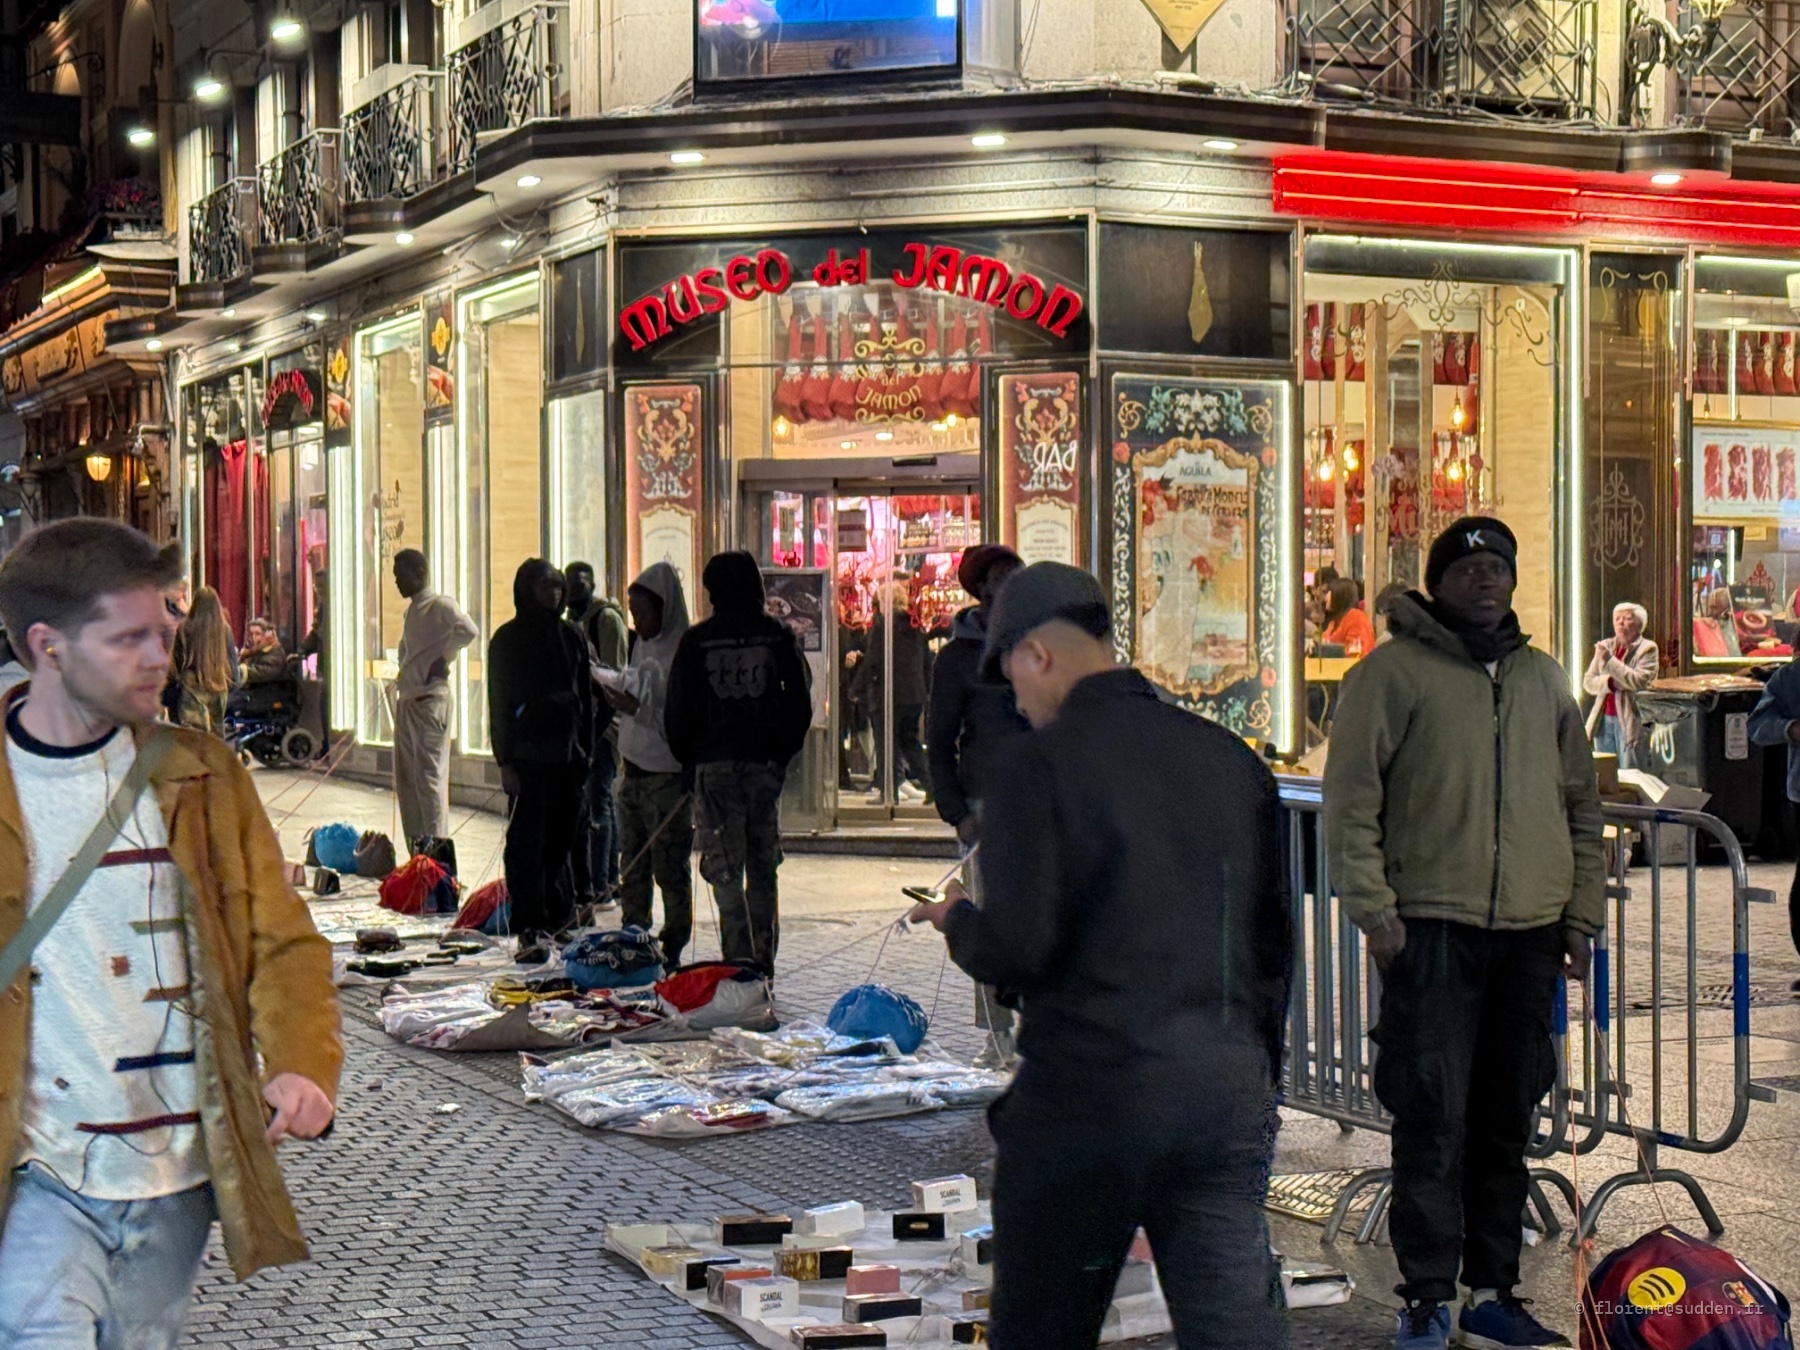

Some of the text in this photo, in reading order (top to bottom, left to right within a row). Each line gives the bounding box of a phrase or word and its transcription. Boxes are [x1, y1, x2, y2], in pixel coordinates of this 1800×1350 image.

[619, 242, 1084, 352] MUSEO del JAMON
[855, 384, 923, 410] JAMON
[1466, 529, 1485, 547] K
